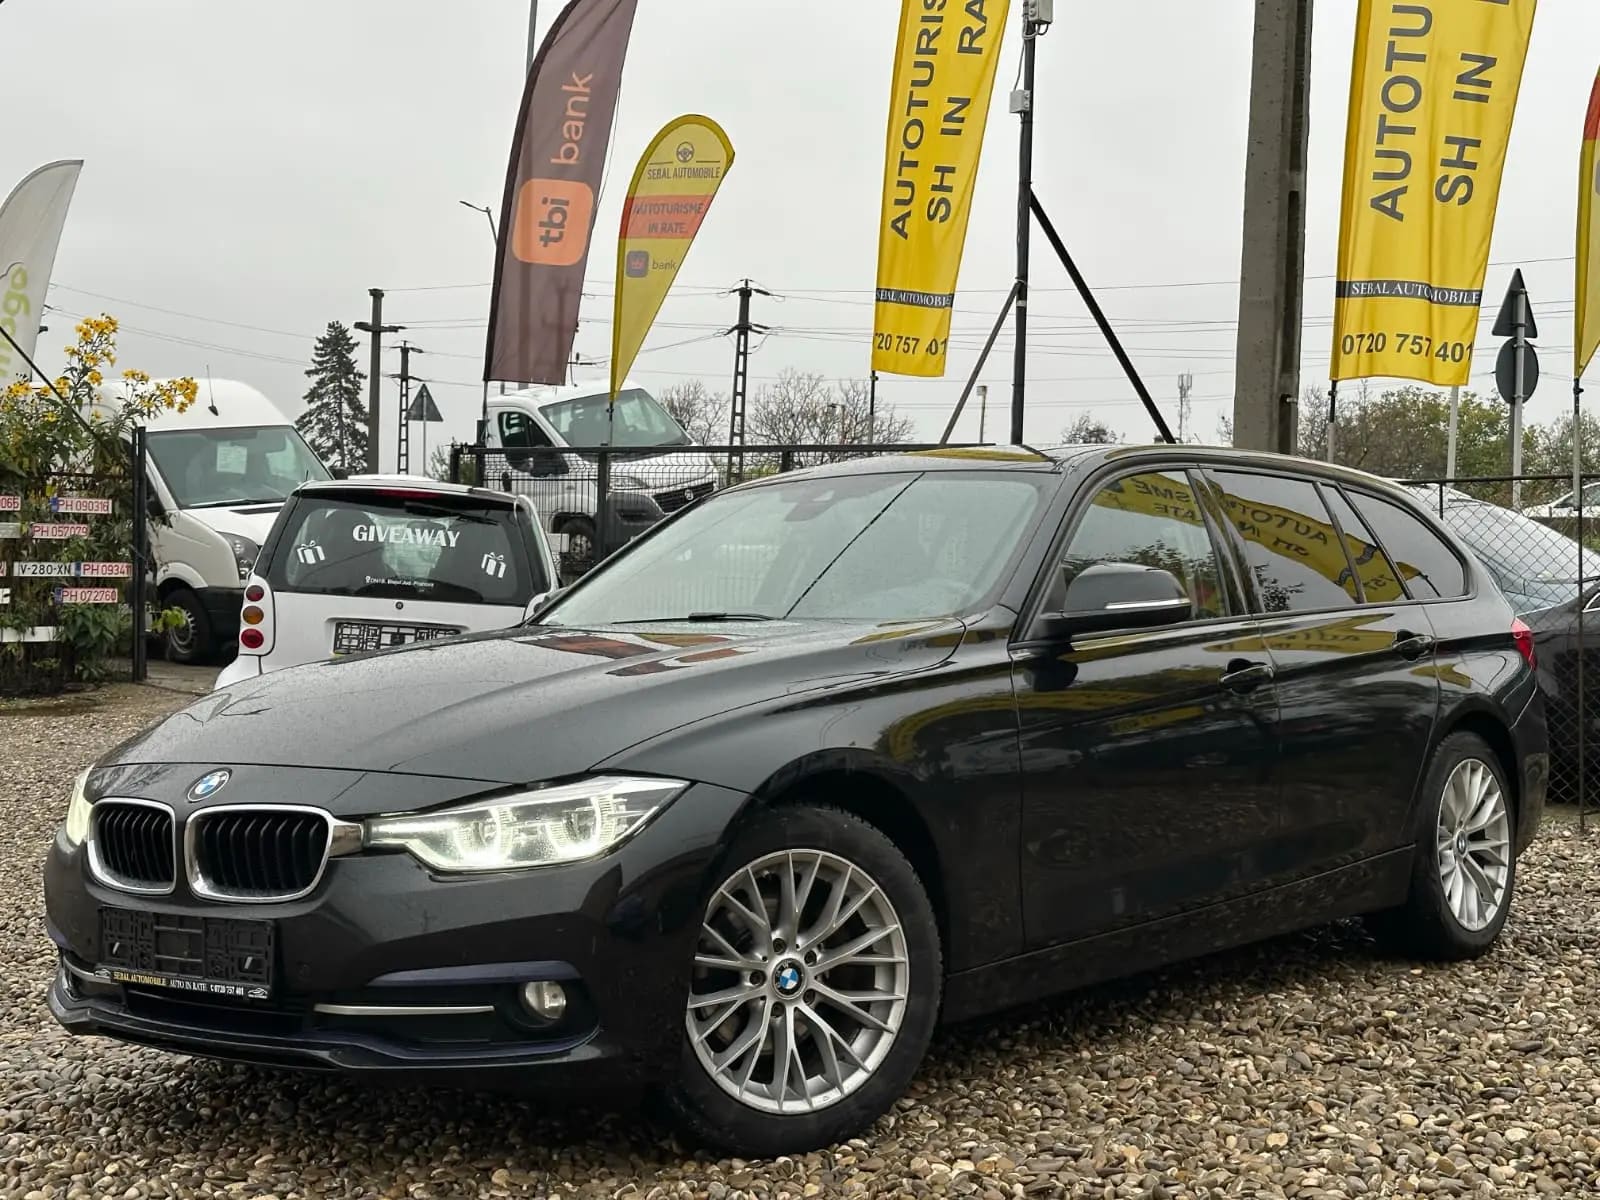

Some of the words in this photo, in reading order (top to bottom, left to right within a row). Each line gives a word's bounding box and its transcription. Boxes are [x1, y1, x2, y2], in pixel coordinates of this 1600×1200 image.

[1453, 52, 1497, 103] IN
[551, 71, 593, 165] bank
[940, 97, 971, 135] IN
[1370, 4, 1433, 222] AUTOTU
[647, 167, 671, 180] SEBAL
[673, 166, 721, 179] AUTOMOBILE
[1435, 135, 1481, 206] SH
[927, 165, 956, 223] SH
[633, 203, 704, 215] AUTOTURISME
[538, 197, 570, 247] tbi
[648, 223, 658, 233] IN
[651, 258, 677, 270] bank
[1352, 282, 1390, 295] SEBAL
[1392, 283, 1481, 304] AUTOMOBILE
[895, 335, 920, 354] 757
[1341, 333, 1387, 355] 0720
[1395, 333, 1432, 357] 757
[58, 499, 73, 511] PH
[33, 527, 49, 537] PH
[51, 527, 88, 538] 057079
[352, 524, 460, 548] GIVEAWAY
[20, 565, 71, 576] V-280-XN
[83, 565, 100, 576] PH
[62, 591, 78, 602] PH
